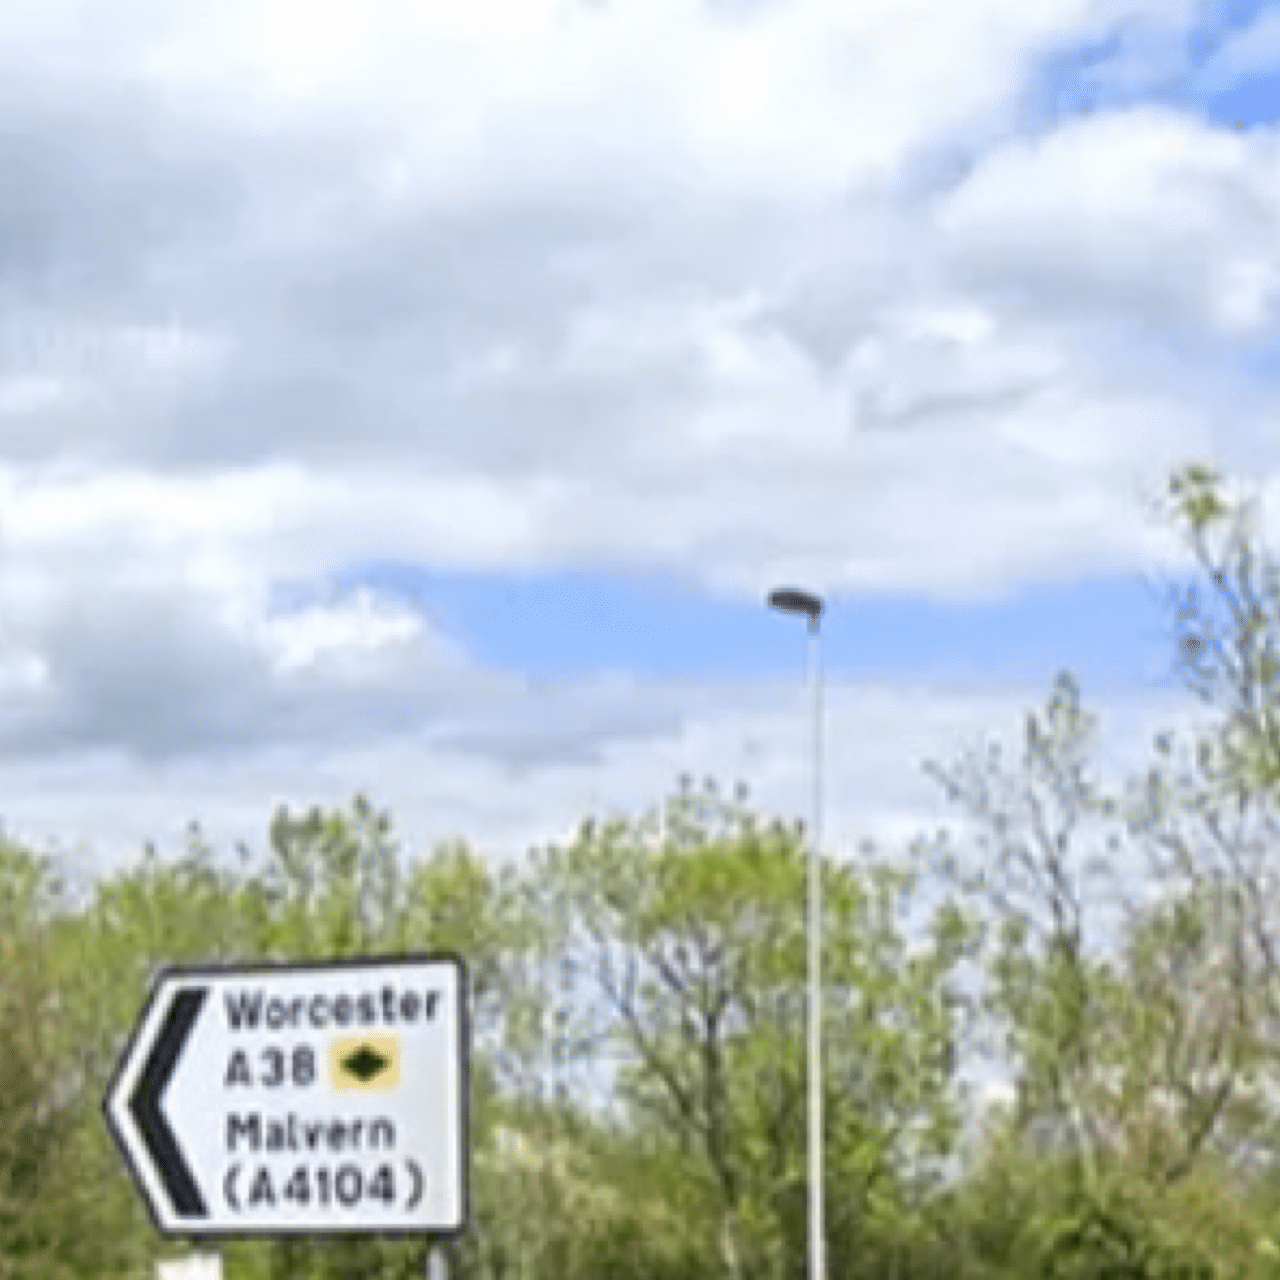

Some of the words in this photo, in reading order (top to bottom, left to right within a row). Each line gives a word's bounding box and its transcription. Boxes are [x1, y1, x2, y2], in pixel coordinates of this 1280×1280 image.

[224, 985, 440, 1030] Worcester
[223, 1044, 316, 1087] A38
[225, 1111, 397, 1152] Malvern
[222, 1158, 426, 1211] (A4104)
